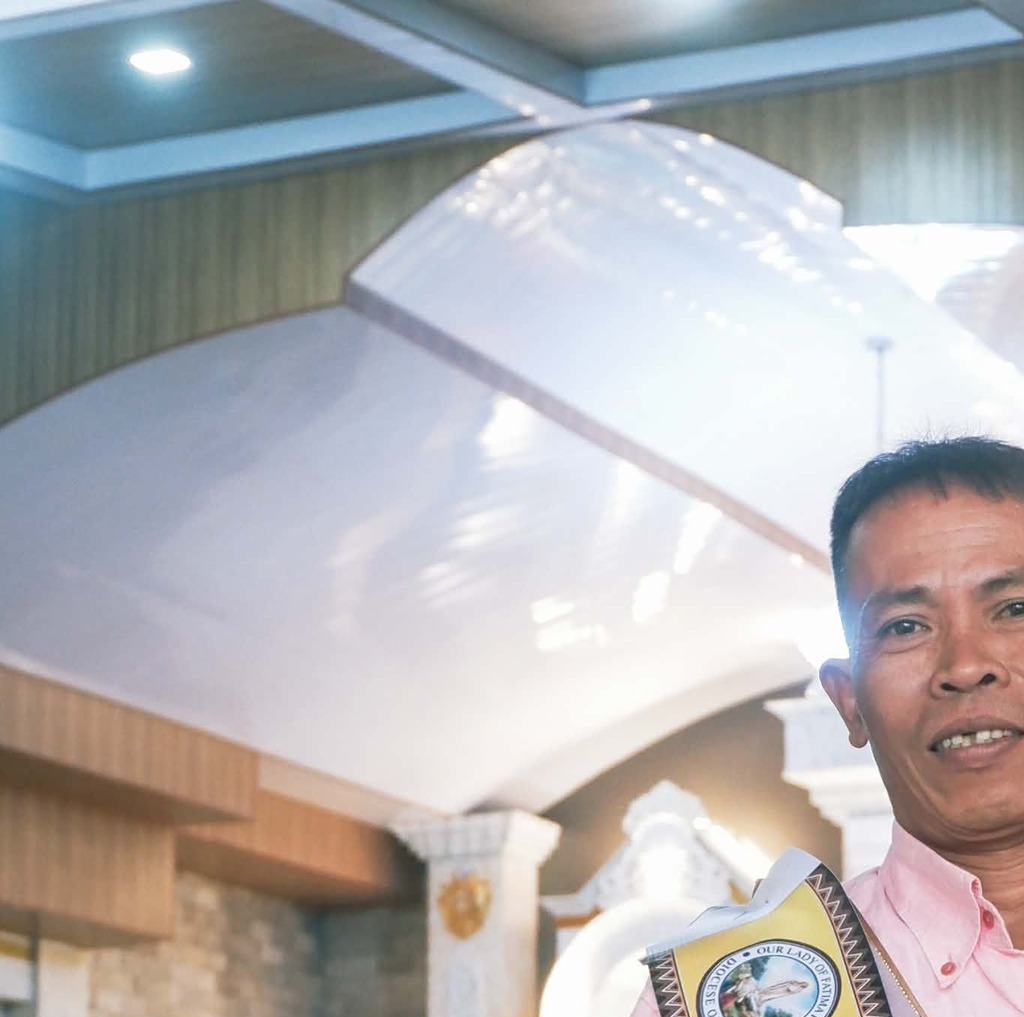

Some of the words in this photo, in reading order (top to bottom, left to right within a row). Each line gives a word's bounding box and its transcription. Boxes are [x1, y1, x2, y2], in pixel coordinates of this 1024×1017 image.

[757, 945, 784, 955] OUR
[787, 946, 819, 965] LADY
[814, 963, 829, 976] OF
[704, 957, 738, 1006] DIOCESE
[815, 976, 832, 1013] FATIMA
